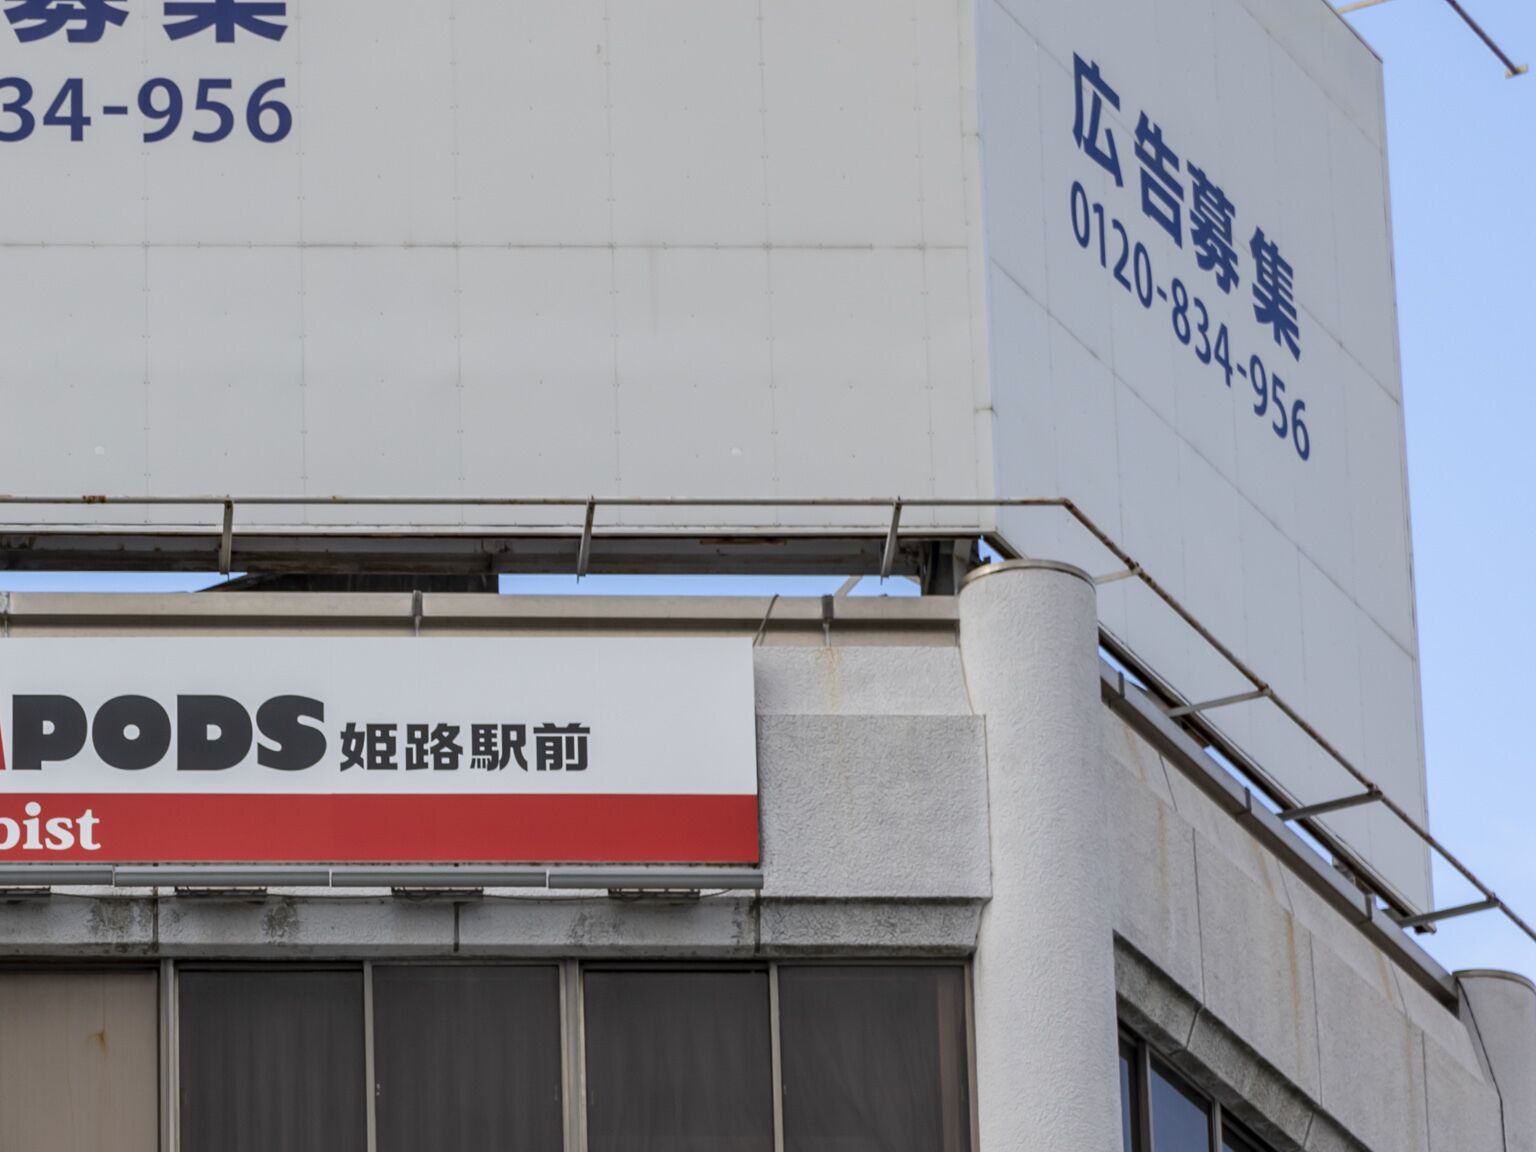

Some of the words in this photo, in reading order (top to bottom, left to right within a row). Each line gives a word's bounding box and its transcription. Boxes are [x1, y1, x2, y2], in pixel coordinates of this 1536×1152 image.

[1070, 181, 1310, 461] 0120-834-956
[1072, 51, 1301, 362] 広告募集
[340, 722, 591, 772] 姫路駅前
